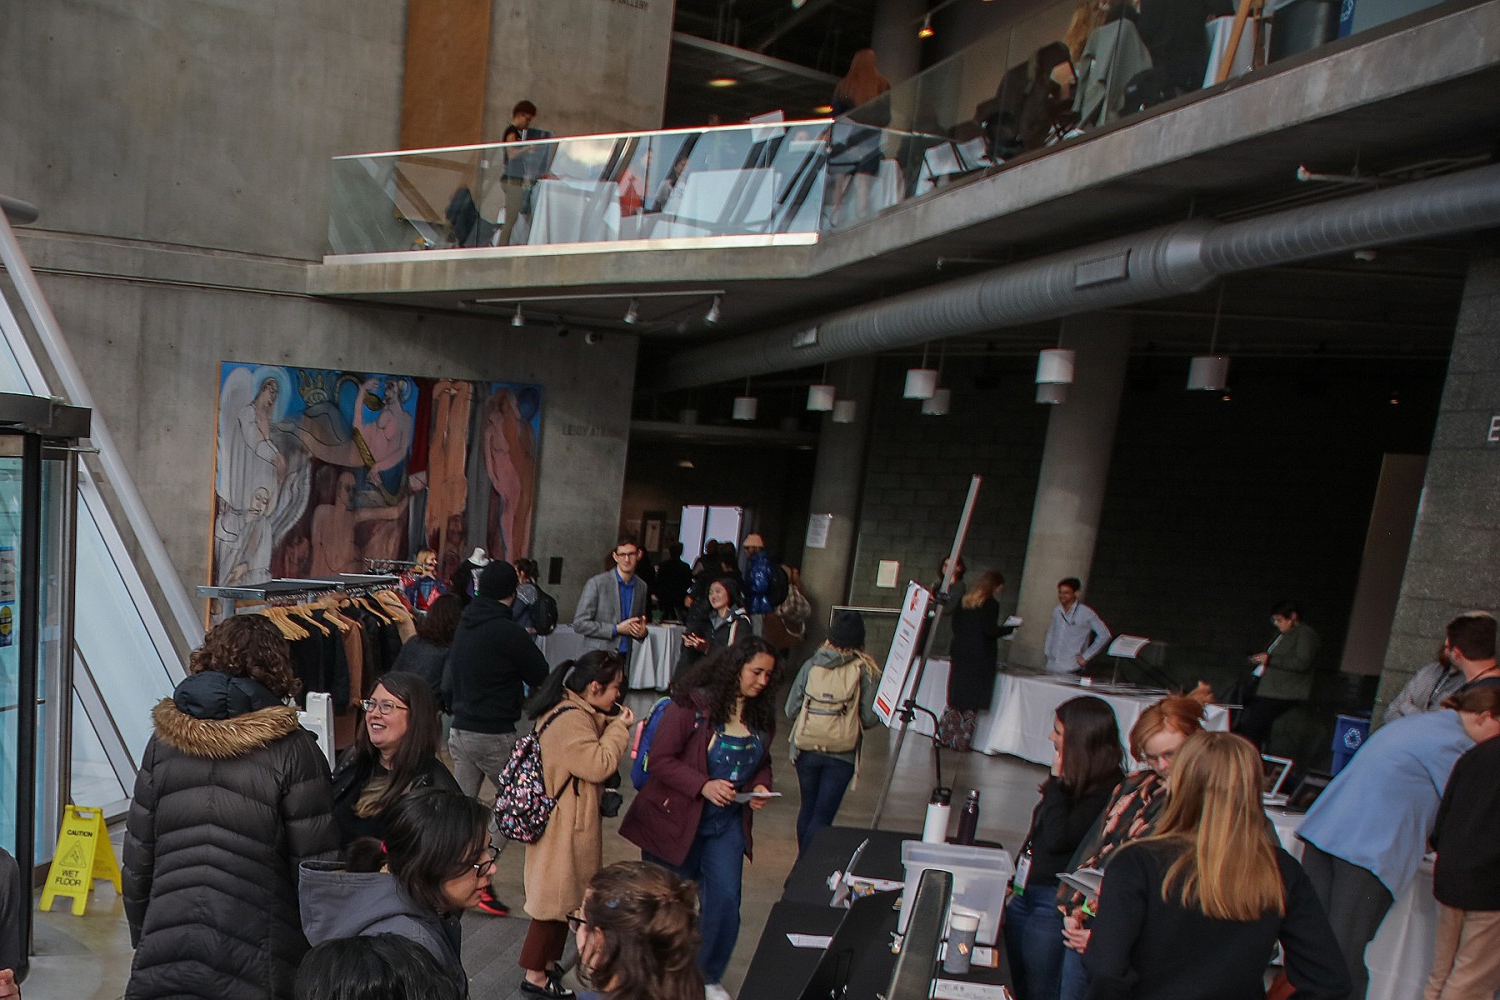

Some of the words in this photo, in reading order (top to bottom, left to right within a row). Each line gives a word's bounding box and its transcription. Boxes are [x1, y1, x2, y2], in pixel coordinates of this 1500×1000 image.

[66, 829, 93, 837] CAUTION
[61, 869, 80, 878] WET
[54, 878, 82, 887] FLOOR
